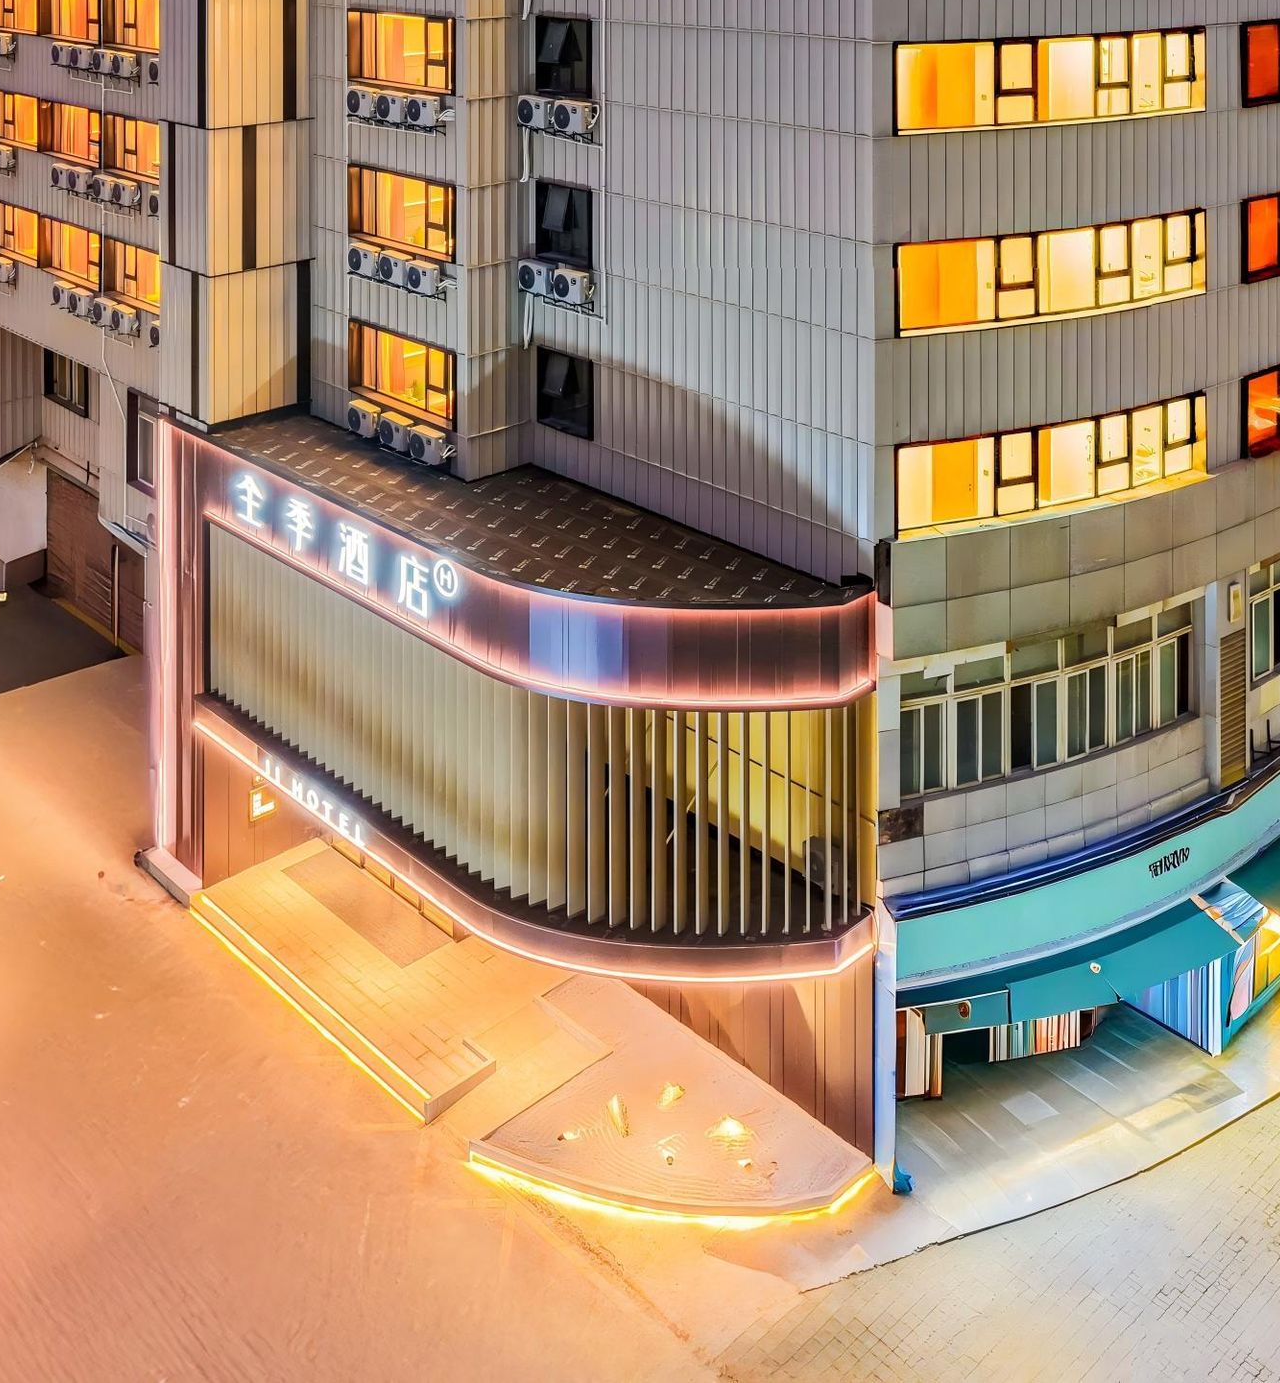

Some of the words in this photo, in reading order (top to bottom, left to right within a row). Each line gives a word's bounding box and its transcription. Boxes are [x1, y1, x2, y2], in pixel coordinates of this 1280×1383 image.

[236, 474, 429, 619] 全季酒店
[263, 758, 281, 785] JI
[291, 777, 365, 847] HOTEL
